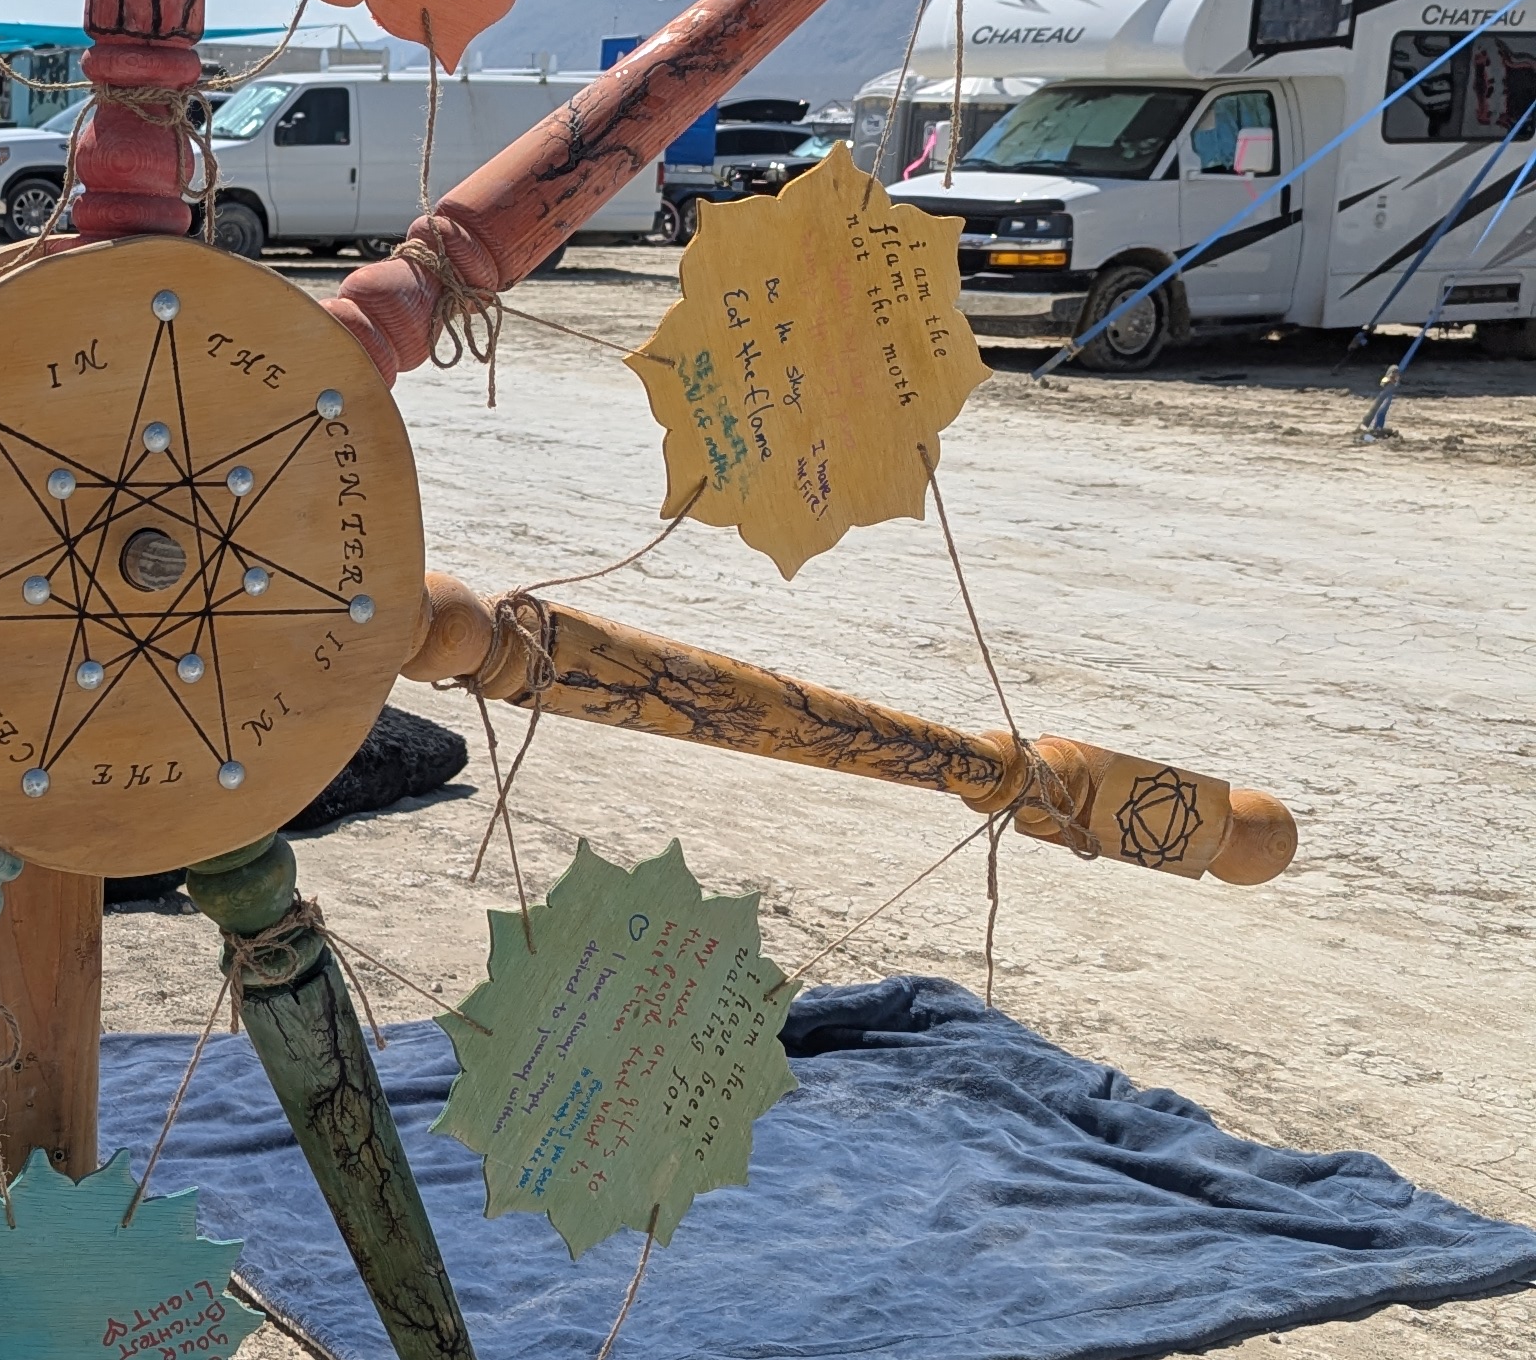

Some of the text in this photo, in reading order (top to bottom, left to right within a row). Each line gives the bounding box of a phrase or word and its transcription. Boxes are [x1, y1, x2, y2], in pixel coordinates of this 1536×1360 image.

[971, 25, 1085, 45] CHATEAU
[869, 223, 908, 303] flame
[846, 214, 869, 262] not
[868, 285, 890, 326] the
[883, 343, 918, 407] moth
[910, 241, 947, 358] i am the
[722, 287, 748, 330] Eat
[735, 340, 762, 383] the
[775, 321, 794, 345] the
[49, 338, 109, 389] IN
[206, 332, 288, 390] THE
[782, 366, 803, 413] sky
[812, 439, 825, 454] I
[325, 420, 368, 593] CENTER
[314, 630, 344, 670] IS
[241, 692, 291, 747] IN
[91, 761, 183, 788] THE
[646, 921, 678, 976] meet
[588, 967, 617, 1004] have
[493, 940, 599, 1134] desired to journey within
[557, 1012, 589, 1060] always
[570, 929, 700, 1174] the people that want to
[664, 948, 748, 1116] waiting for
[681, 973, 760, 1128] i have been
[744, 1013, 764, 1047] am
[588, 939, 720, 1191] my needs are gifts to
[722, 1062, 744, 1101] the
[526, 1071, 555, 1115] simply
[695, 1116, 719, 1162] one
